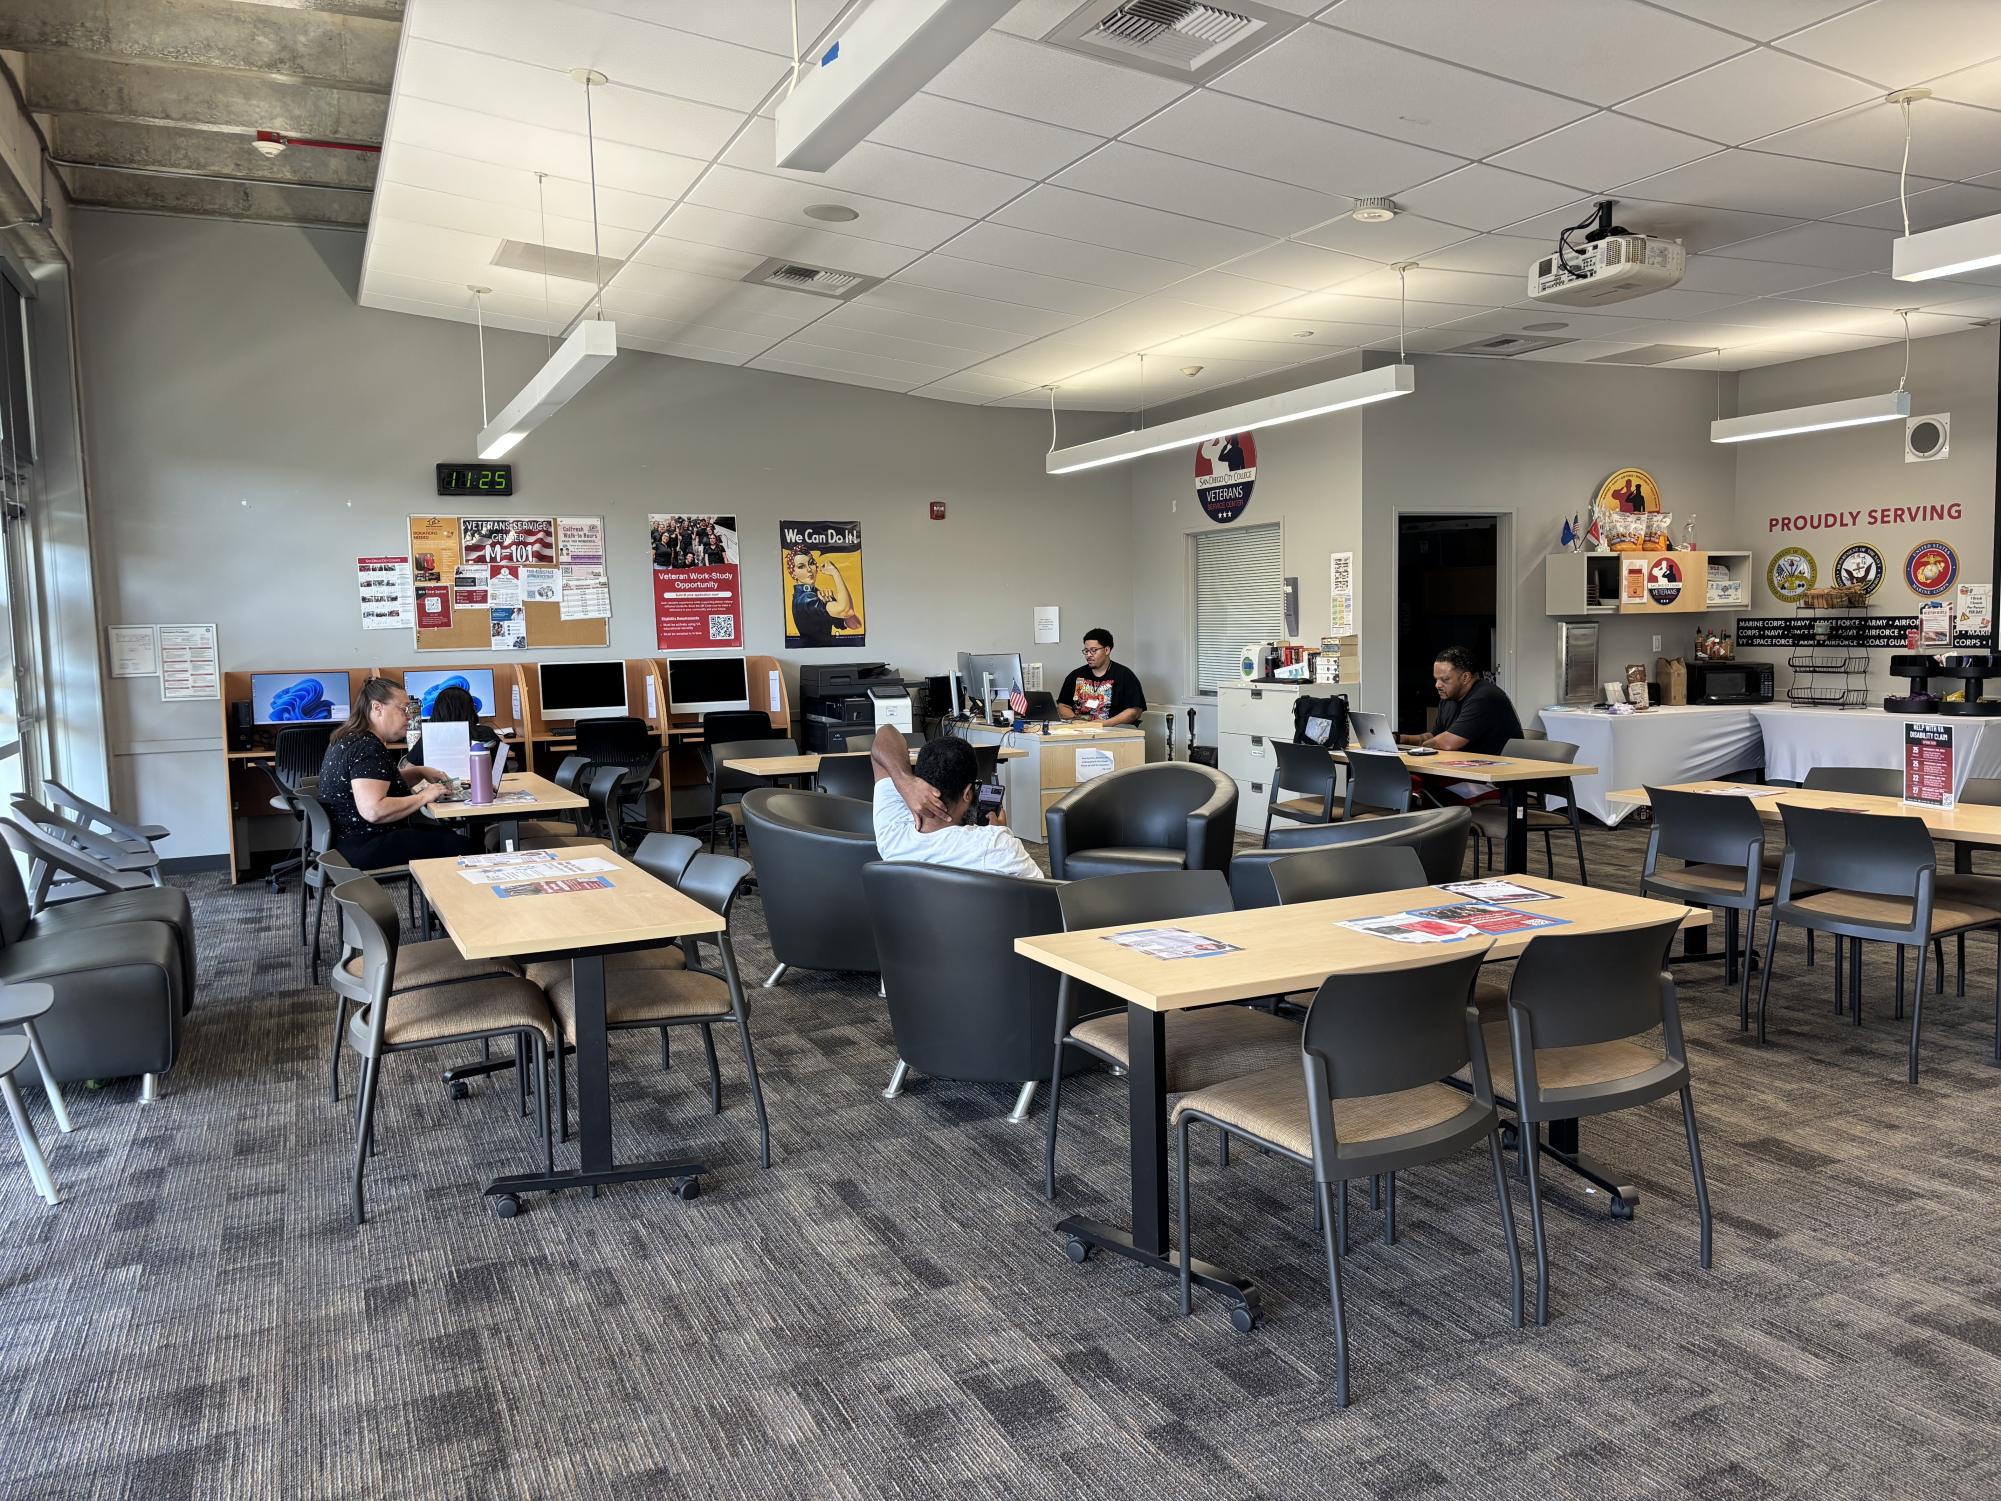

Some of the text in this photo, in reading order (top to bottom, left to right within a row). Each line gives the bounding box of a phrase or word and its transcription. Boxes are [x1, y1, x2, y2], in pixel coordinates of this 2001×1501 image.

[452, 471, 505, 489] 11:25
[1206, 486, 1243, 502] VETERANS
[1768, 502, 1962, 532] PROUDLY SERVING
[465, 521, 549, 530] VETERANS SERVICE
[785, 528, 857, 544] We Can Do It!
[485, 545, 533, 562] M-101
[659, 572, 733, 580] Veteran Work-Study
[675, 581, 718, 589] Opportunity
[1652, 588, 1677, 596] VETERANS
[1909, 731, 1948, 741] DISABILITY CLAIM
